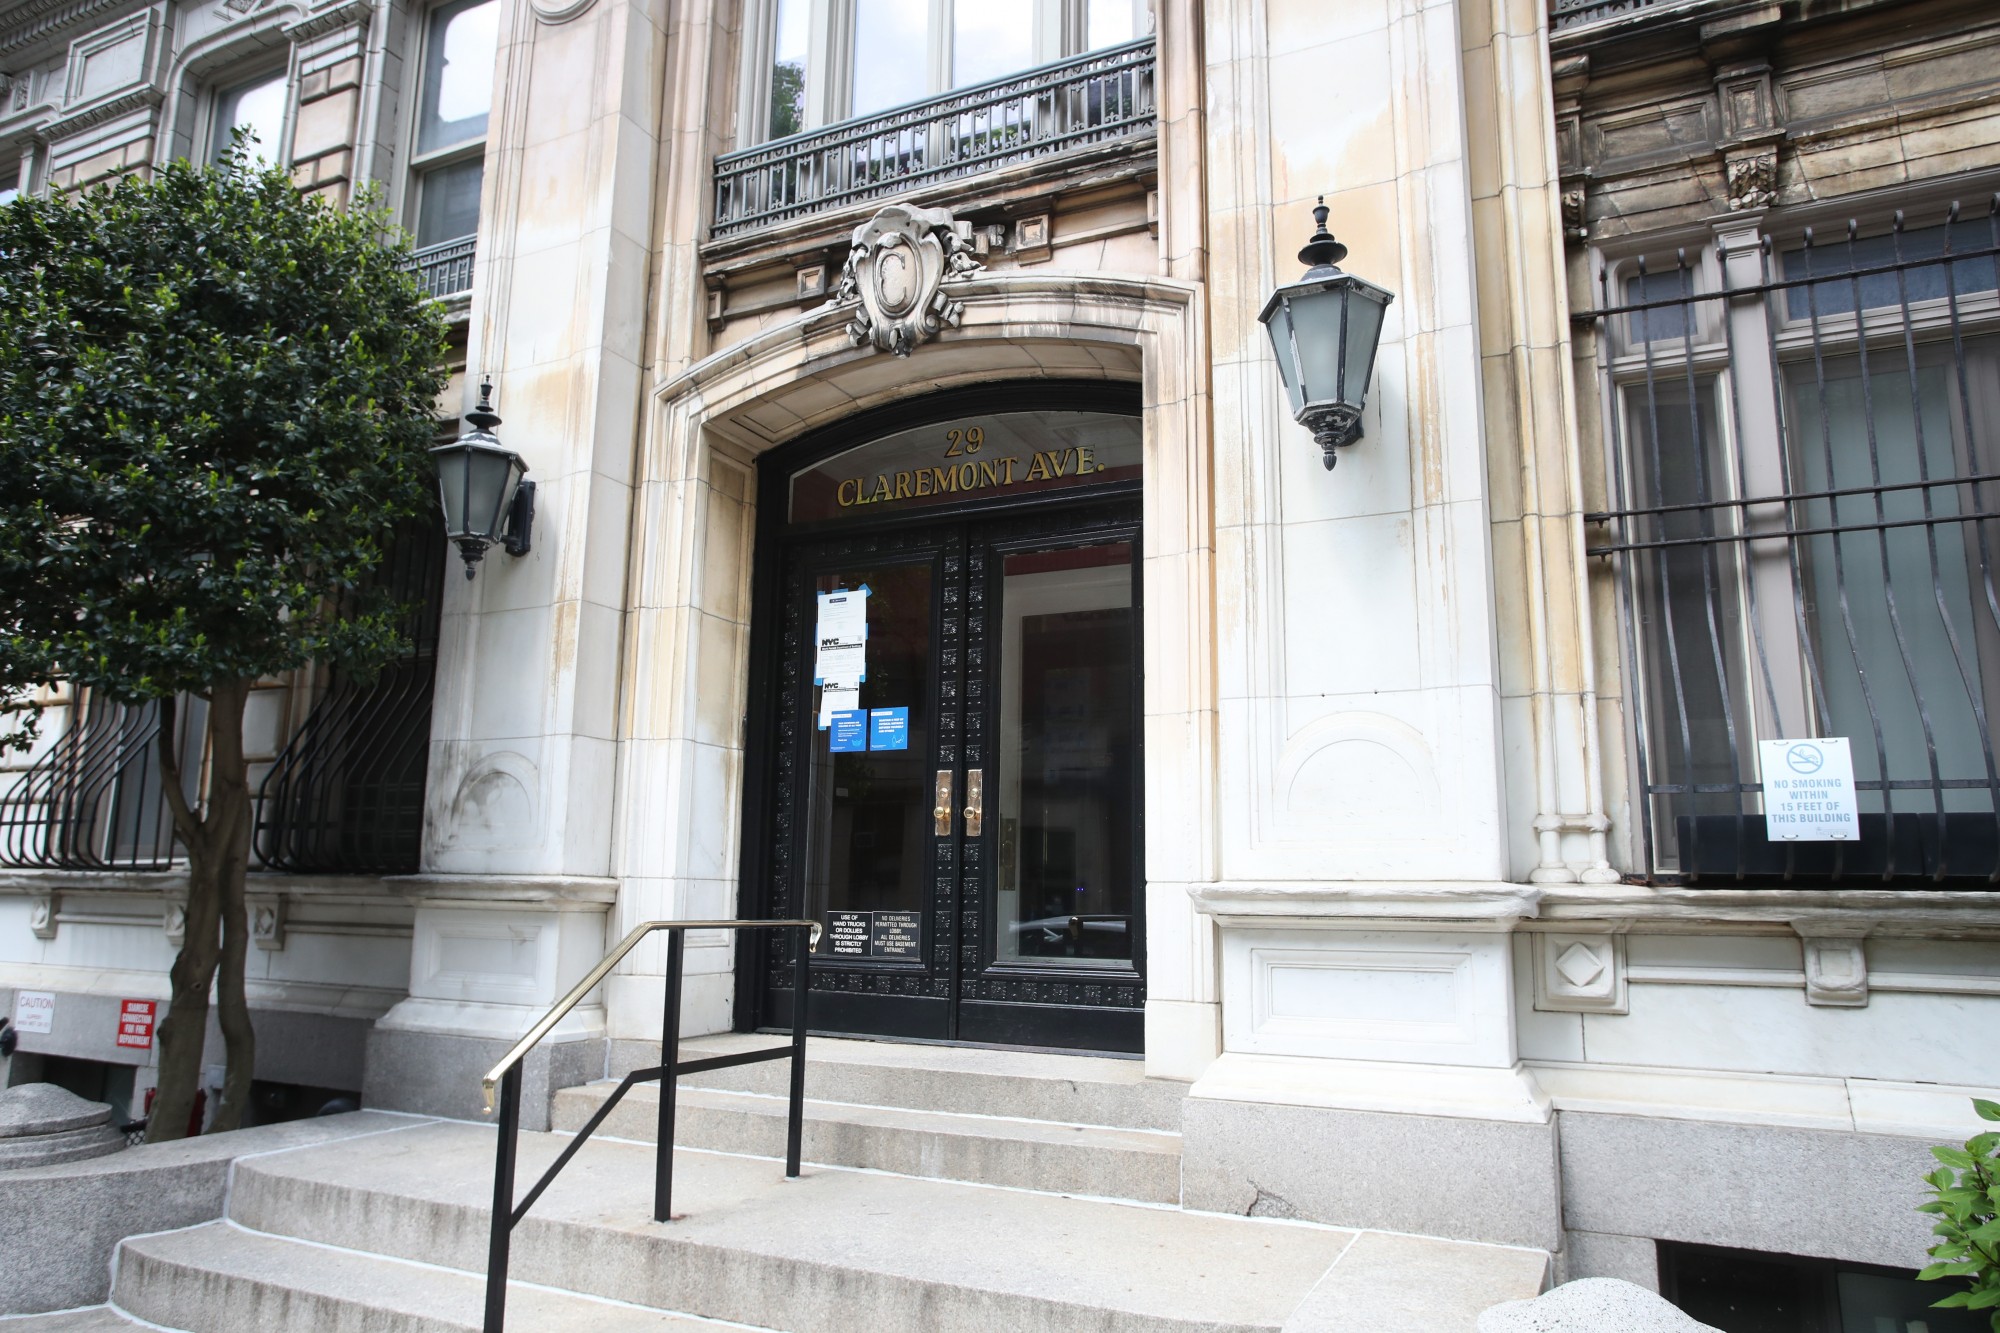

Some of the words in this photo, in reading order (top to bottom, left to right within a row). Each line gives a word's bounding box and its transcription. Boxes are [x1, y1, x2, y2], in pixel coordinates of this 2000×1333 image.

[944, 425, 985, 458] 29
[836, 456, 1019, 507] CLAREMONT
[1025, 445, 1106, 484] AVE.
[1774, 780, 1788, 789] NO
[1792, 778, 1842, 788] SMOKING
[1788, 790, 1828, 800] WITHIN
[1780, 802, 1794, 811] 15
[1797, 802, 1822, 811] FEET
[1826, 802, 1840, 811] OF
[1772, 814, 1797, 823] THIS
[1799, 813, 1851, 823] BUILDING
[20, 996, 54, 1009] CAUTION
[124, 1024, 135, 1033] FOR
[135, 1024, 147, 1034] FIRE
[118, 1034, 151, 1046] DEPARTMENT
